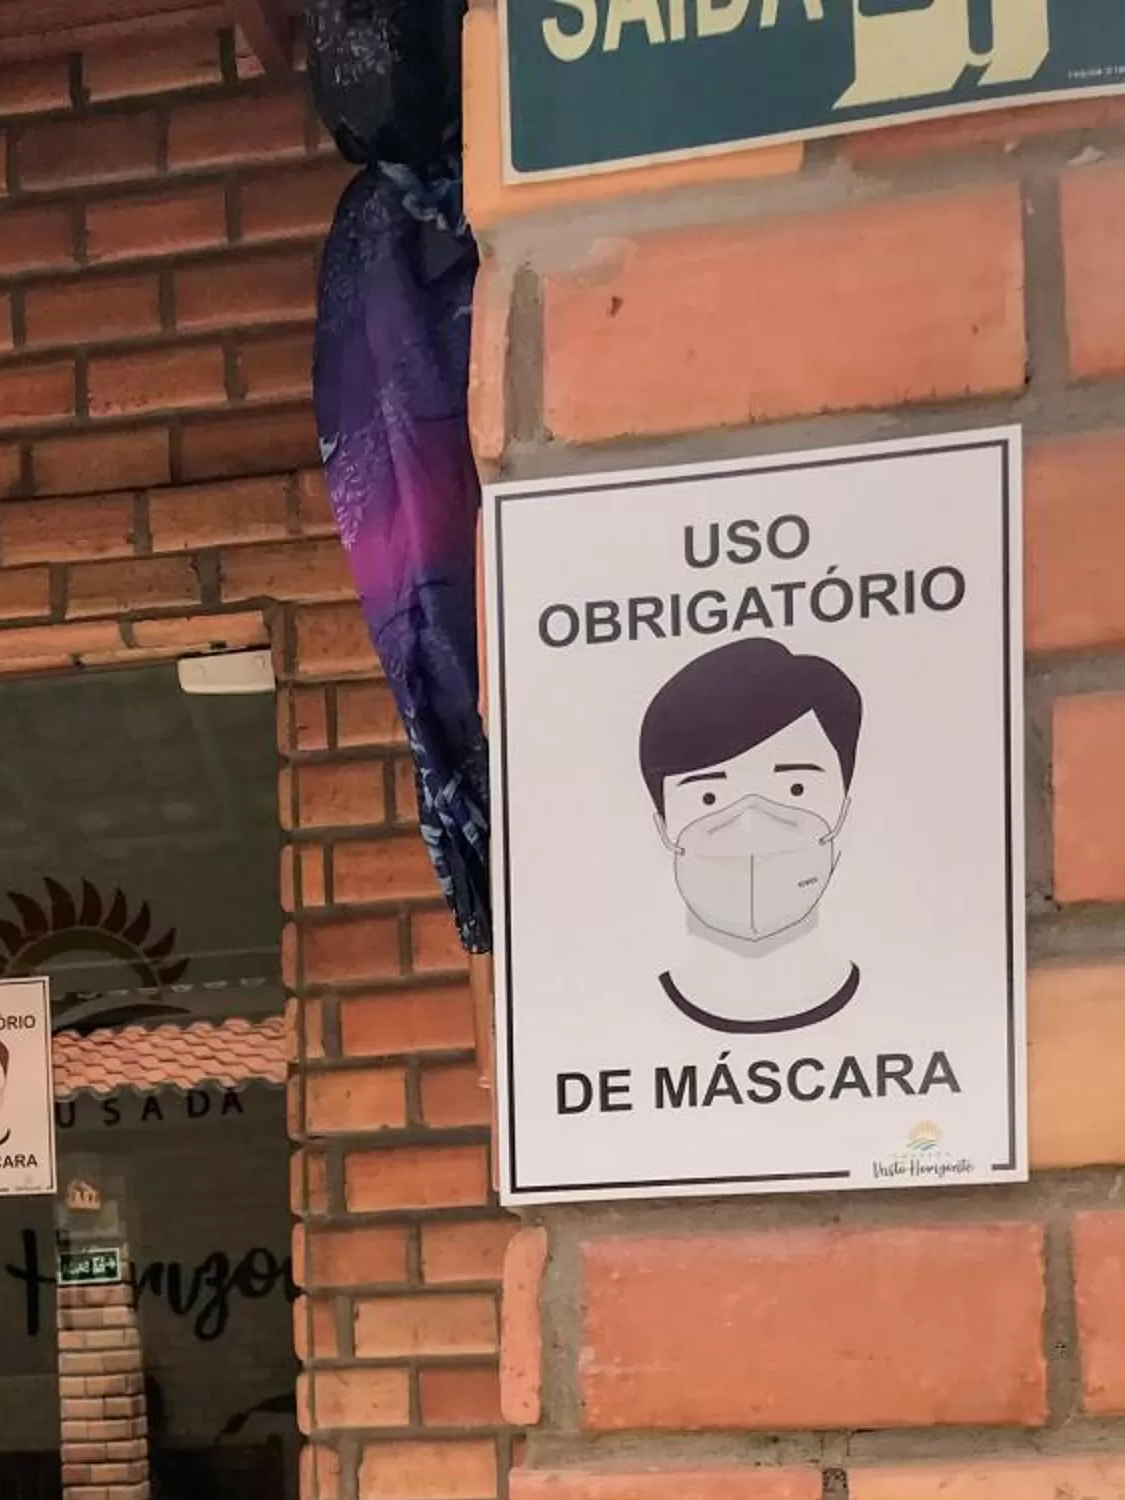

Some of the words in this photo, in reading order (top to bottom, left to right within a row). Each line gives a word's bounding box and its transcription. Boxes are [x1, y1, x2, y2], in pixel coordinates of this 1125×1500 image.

[683, 514, 811, 569] USO
[538, 564, 967, 648] OBRIGATÓRIO
[556, 1069, 634, 1115] DE
[654, 1050, 962, 1108] MÁSCARA
